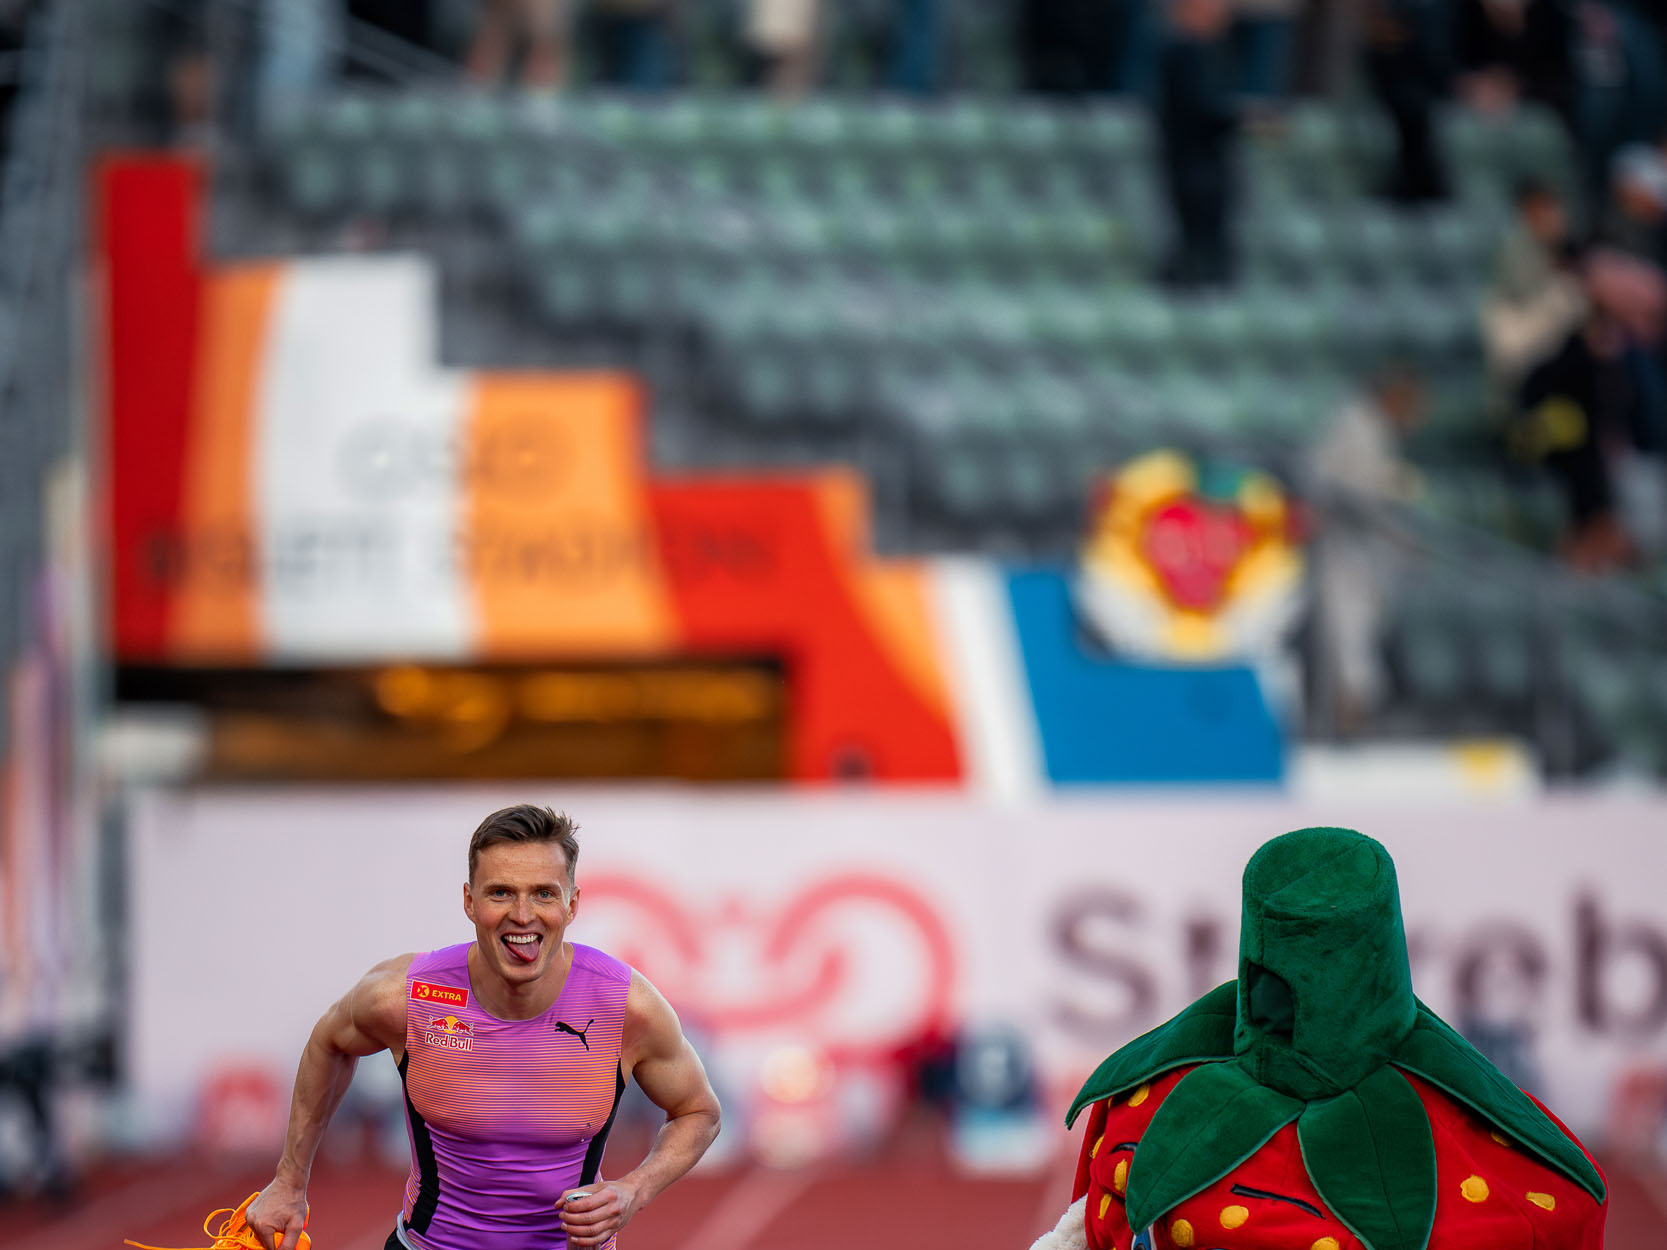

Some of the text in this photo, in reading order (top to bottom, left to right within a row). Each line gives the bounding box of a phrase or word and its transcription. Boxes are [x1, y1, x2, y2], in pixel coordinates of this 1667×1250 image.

[432, 990, 462, 1002] EXTRA
[425, 1031, 473, 1052] Red Bull
